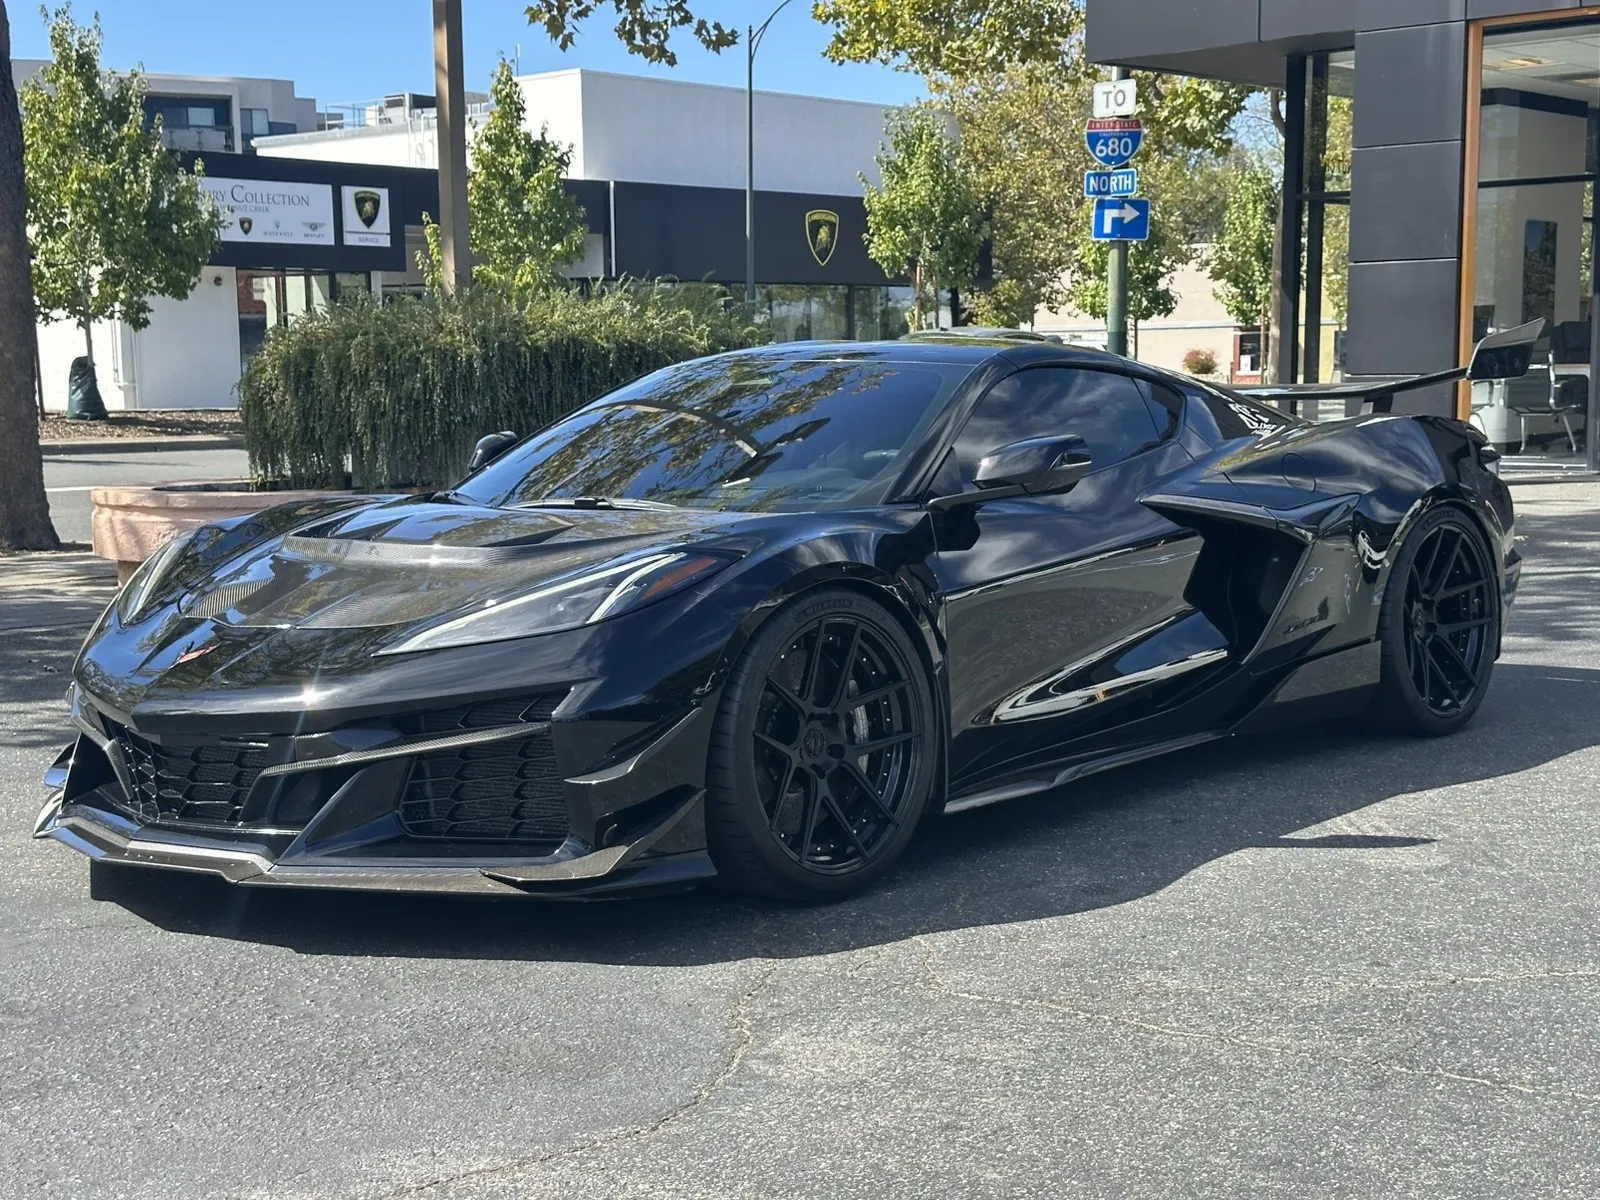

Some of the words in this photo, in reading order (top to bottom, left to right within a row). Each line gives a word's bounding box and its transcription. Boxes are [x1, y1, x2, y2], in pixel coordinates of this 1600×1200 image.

[1102, 89, 1126, 108] TO
[1091, 121, 1137, 129] INTERSTATE
[1095, 137, 1132, 157] 680
[1089, 174, 1132, 192] NORTH
